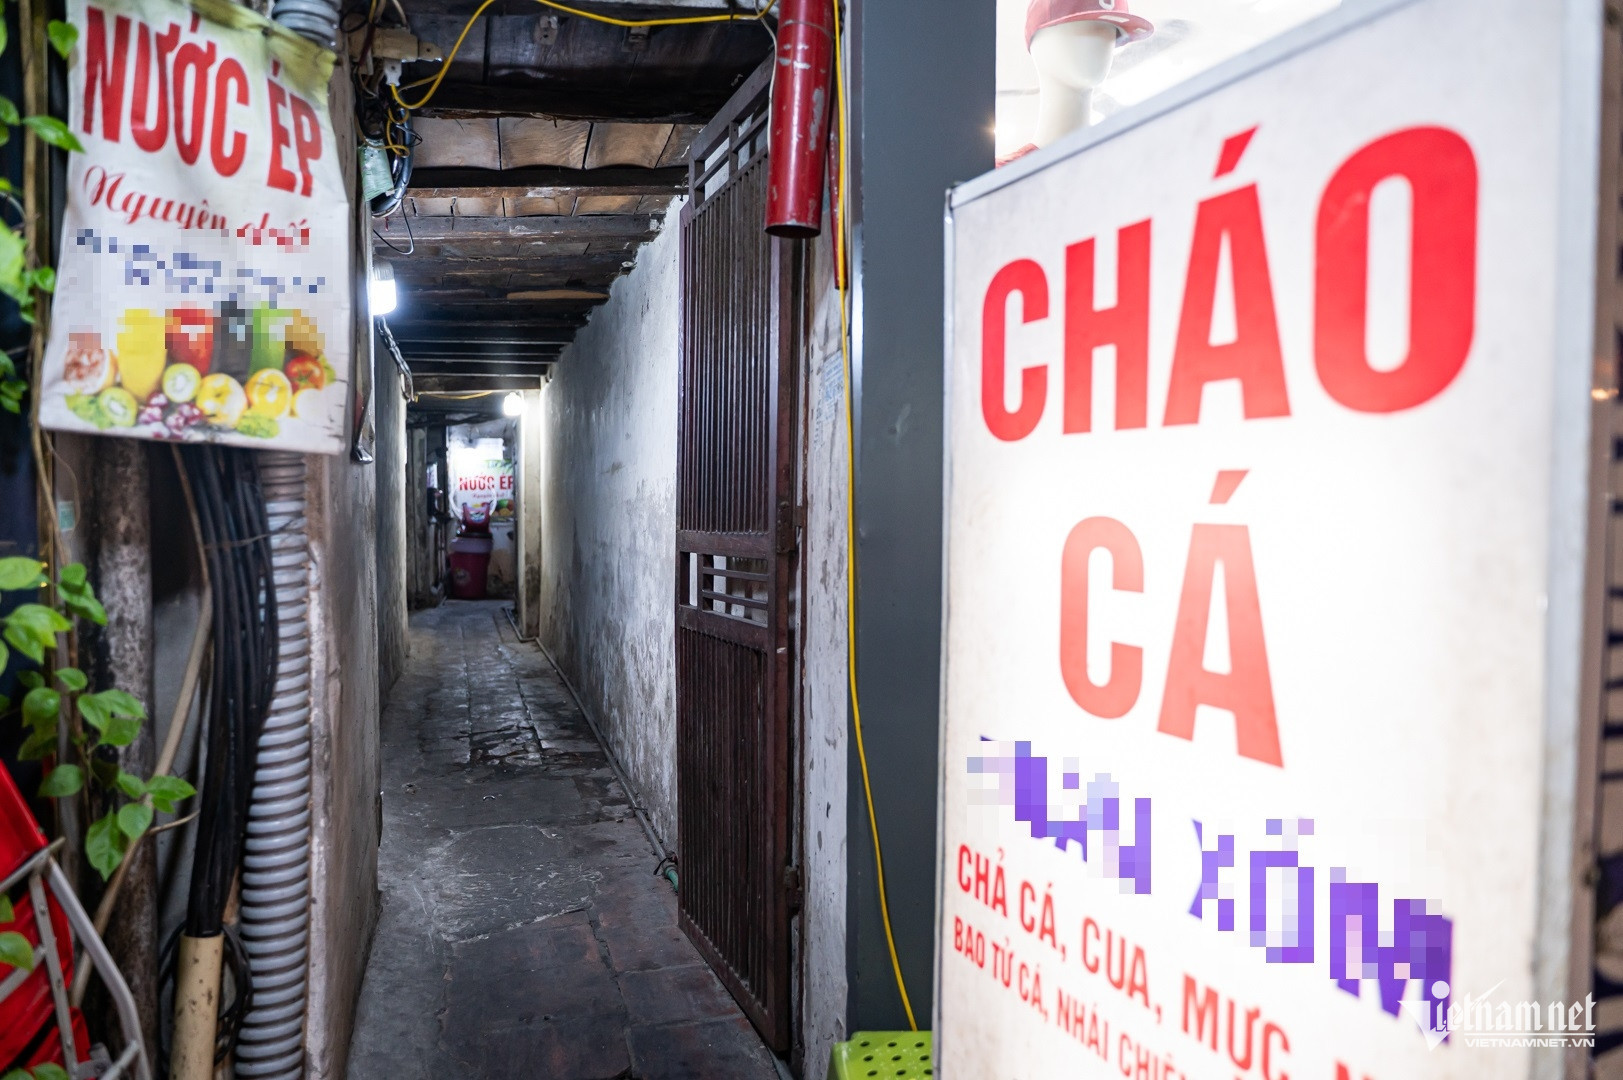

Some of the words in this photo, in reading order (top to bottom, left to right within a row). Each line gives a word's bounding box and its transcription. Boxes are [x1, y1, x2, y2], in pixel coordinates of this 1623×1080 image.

[82, 6, 250, 178] NƯỚC
[267, 60, 323, 198] ÉP
[84, 165, 228, 229] Nguyên
[981, 123, 1479, 442] CHÁO
[1059, 468, 1285, 769] CÁ
[954, 915, 985, 969] BAO
[992, 935, 1014, 989] TỬ
[1019, 963, 1049, 1024] CÁ,
[1058, 987, 1109, 1062] NHÁI
[958, 843, 1008, 918] CHẢ
[1020, 880, 1067, 962] CÁ,
[1082, 915, 1162, 1025] CUA,
